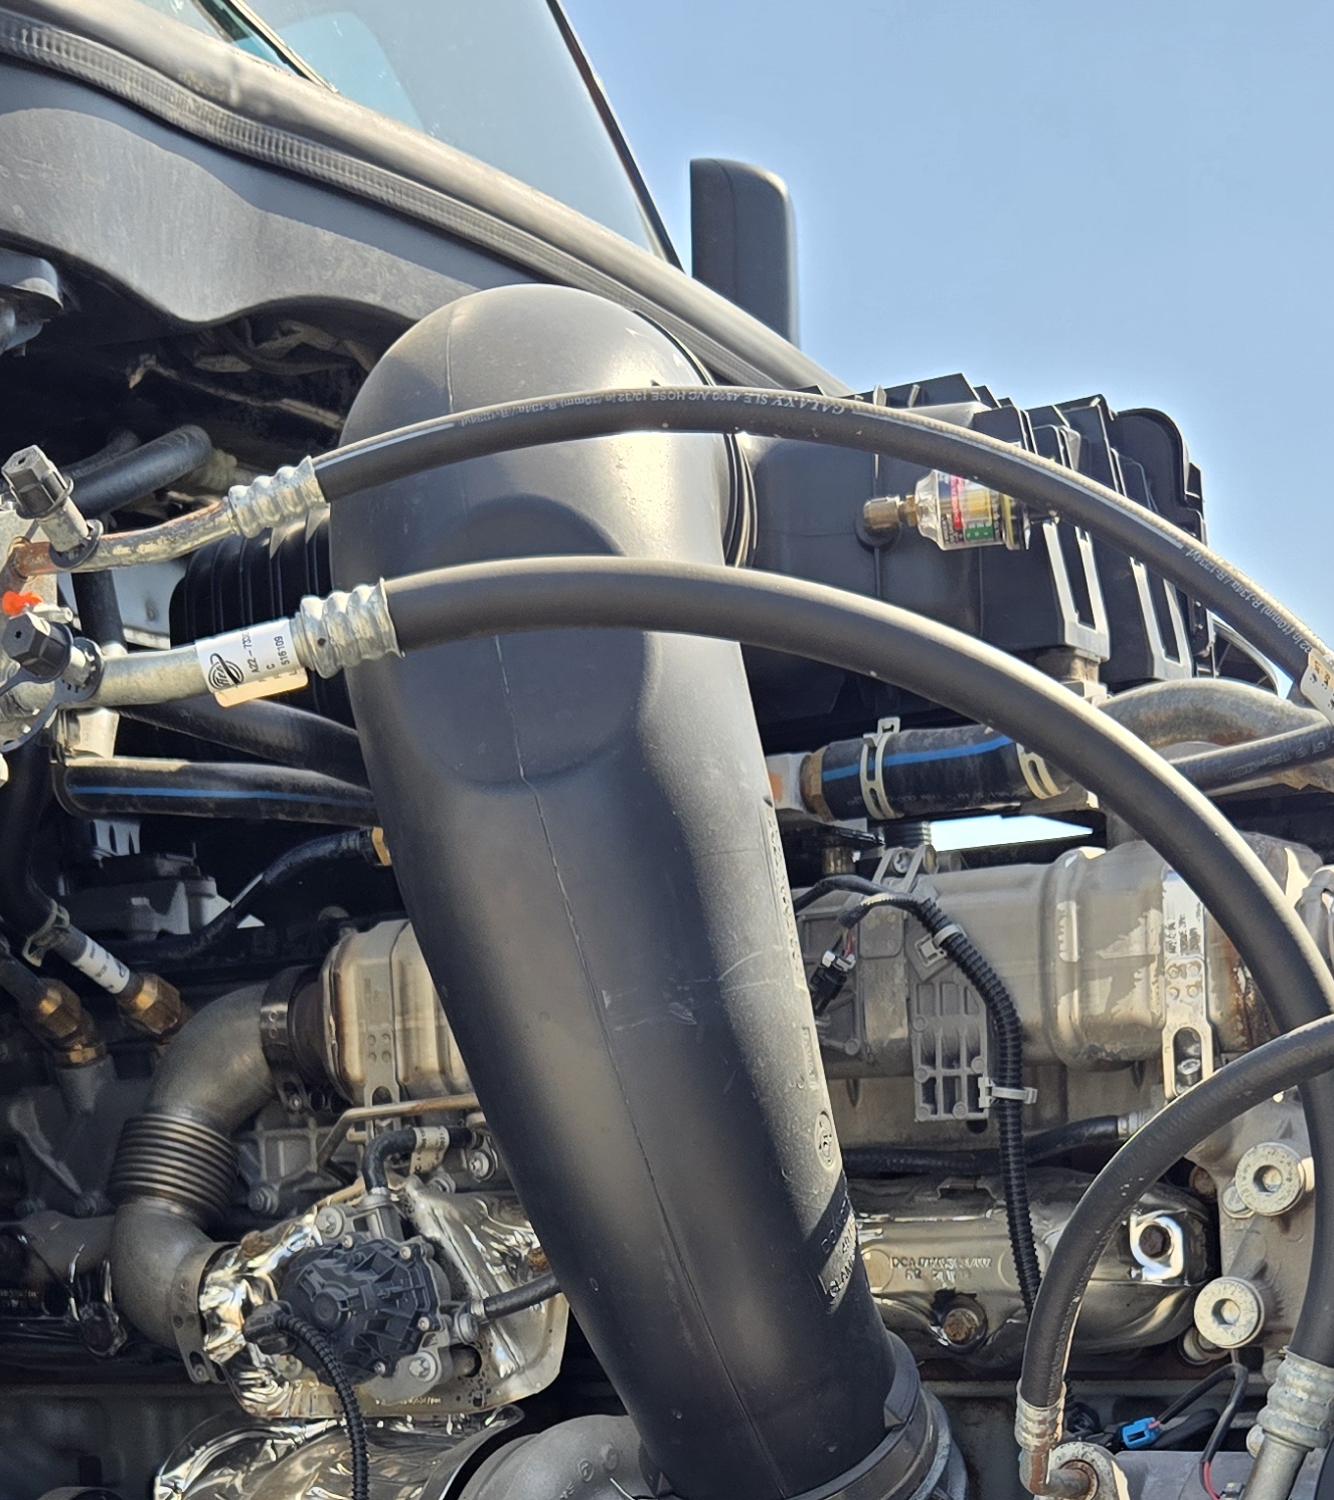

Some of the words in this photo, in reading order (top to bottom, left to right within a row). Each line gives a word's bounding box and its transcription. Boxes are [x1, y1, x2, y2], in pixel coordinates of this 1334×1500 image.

[651, 390, 686, 402] HOSE
[771, 395, 845, 415] GALAXY
[1259, 605, 1297, 638] (10mm)
[273, 635, 291, 667] 516109
